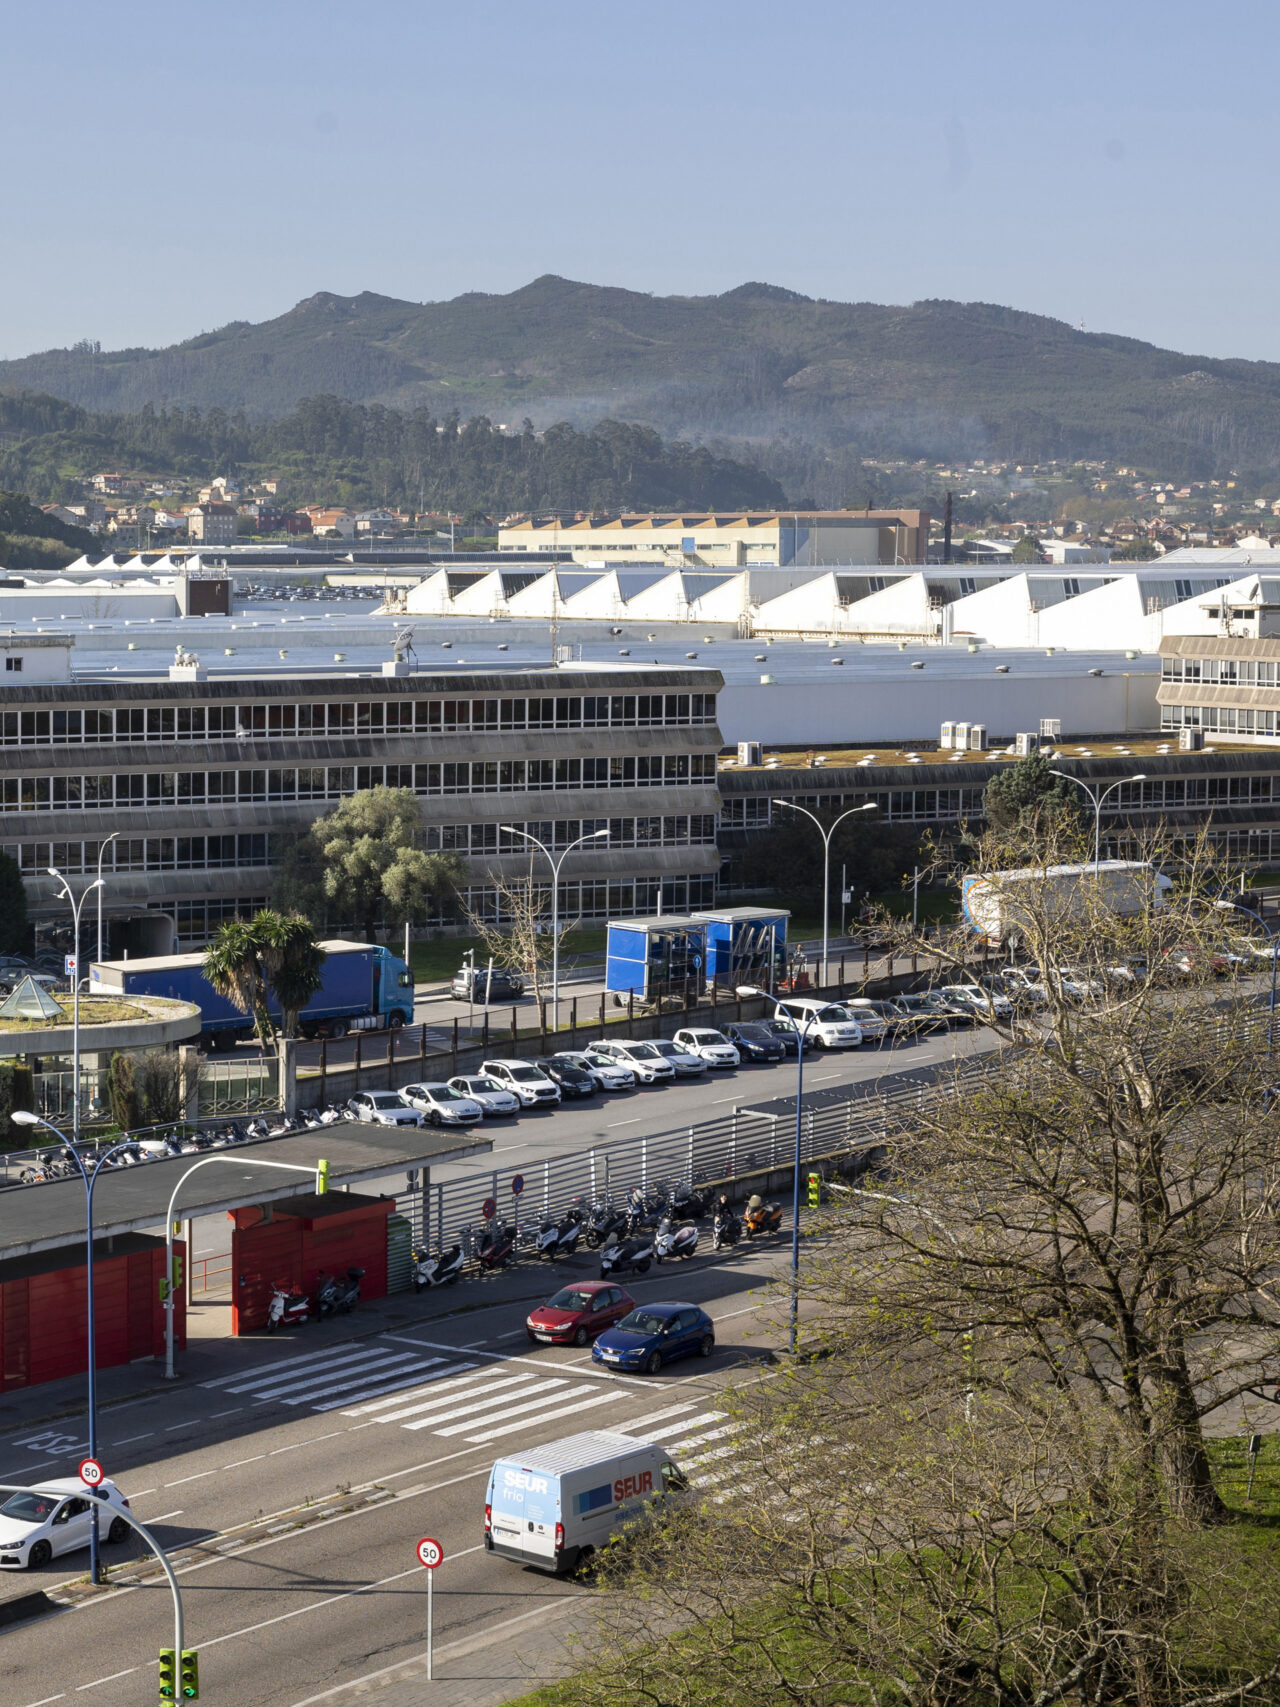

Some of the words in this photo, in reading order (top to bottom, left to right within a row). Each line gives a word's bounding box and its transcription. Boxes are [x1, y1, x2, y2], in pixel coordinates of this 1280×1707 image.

[84, 1467, 98, 1478] 50
[503, 1470, 548, 1495] SEUR
[614, 1471, 653, 1502] SEUR
[422, 1547, 437, 1559] 50
